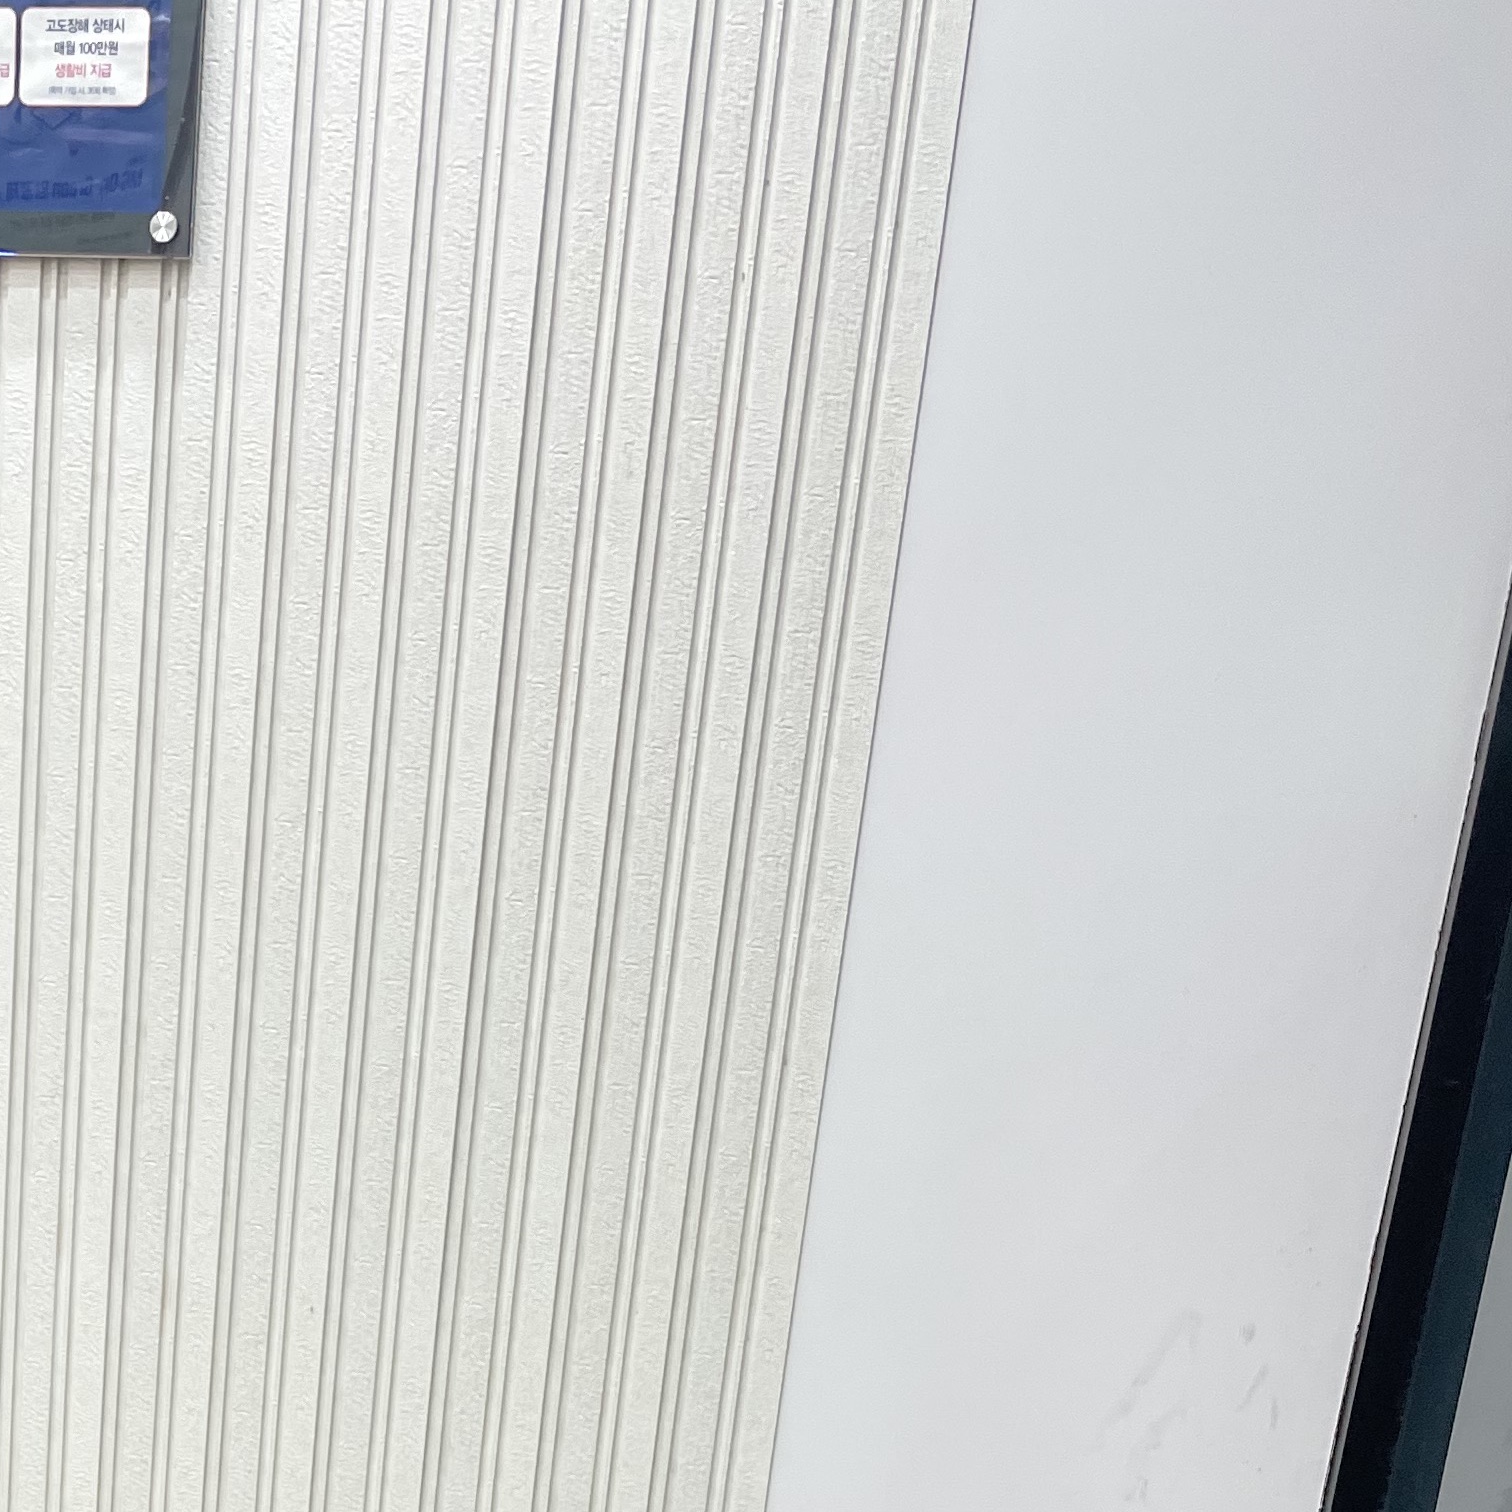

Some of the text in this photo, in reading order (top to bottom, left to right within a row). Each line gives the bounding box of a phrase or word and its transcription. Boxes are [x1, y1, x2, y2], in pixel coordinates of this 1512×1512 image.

[45, 18, 125, 33] 고도장해 상태시
[54, 40, 119, 56] 매월 100만원
[55, 63, 112, 78] 생활비 지급
